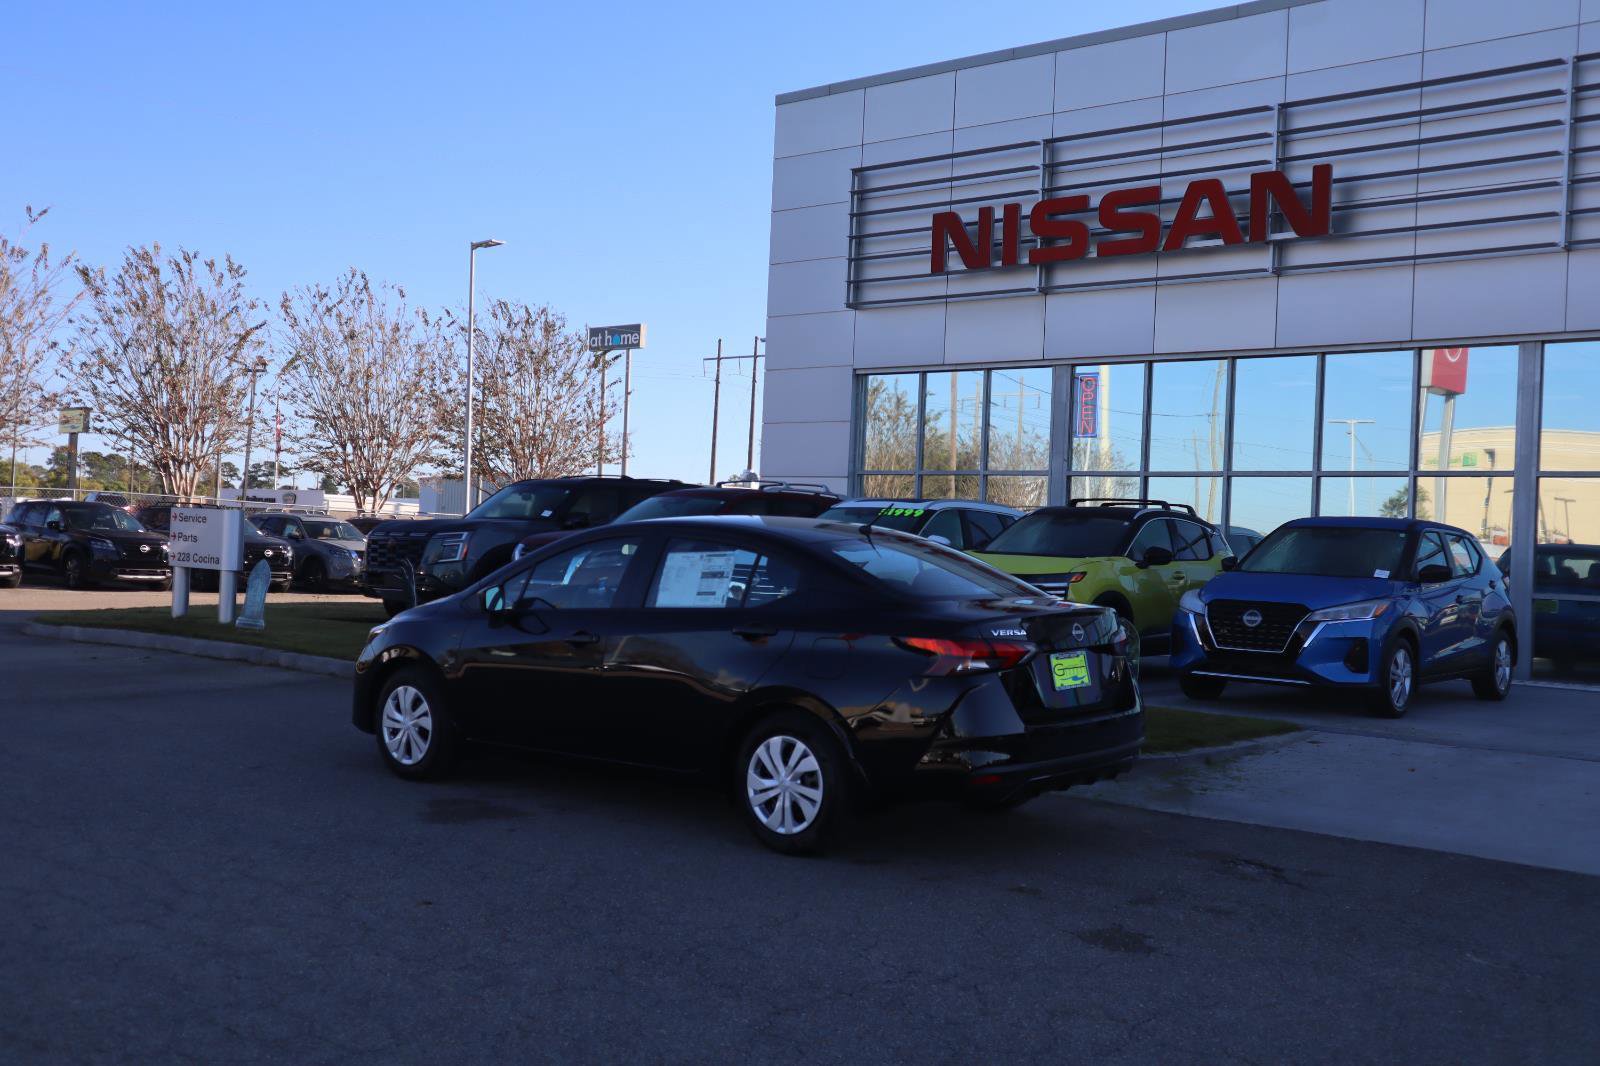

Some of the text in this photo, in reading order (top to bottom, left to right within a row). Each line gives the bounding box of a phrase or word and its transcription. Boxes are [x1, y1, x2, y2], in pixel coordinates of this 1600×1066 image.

[930, 163, 1333, 274] NISSAN
[590, 330, 640, 347] at home
[1081, 377, 1098, 434] OPEN
[178, 512, 207, 523] Service
[177, 532, 198, 543] Parts
[177, 552, 220, 565] 228 Cocina
[991, 629, 1027, 637] VERSA
